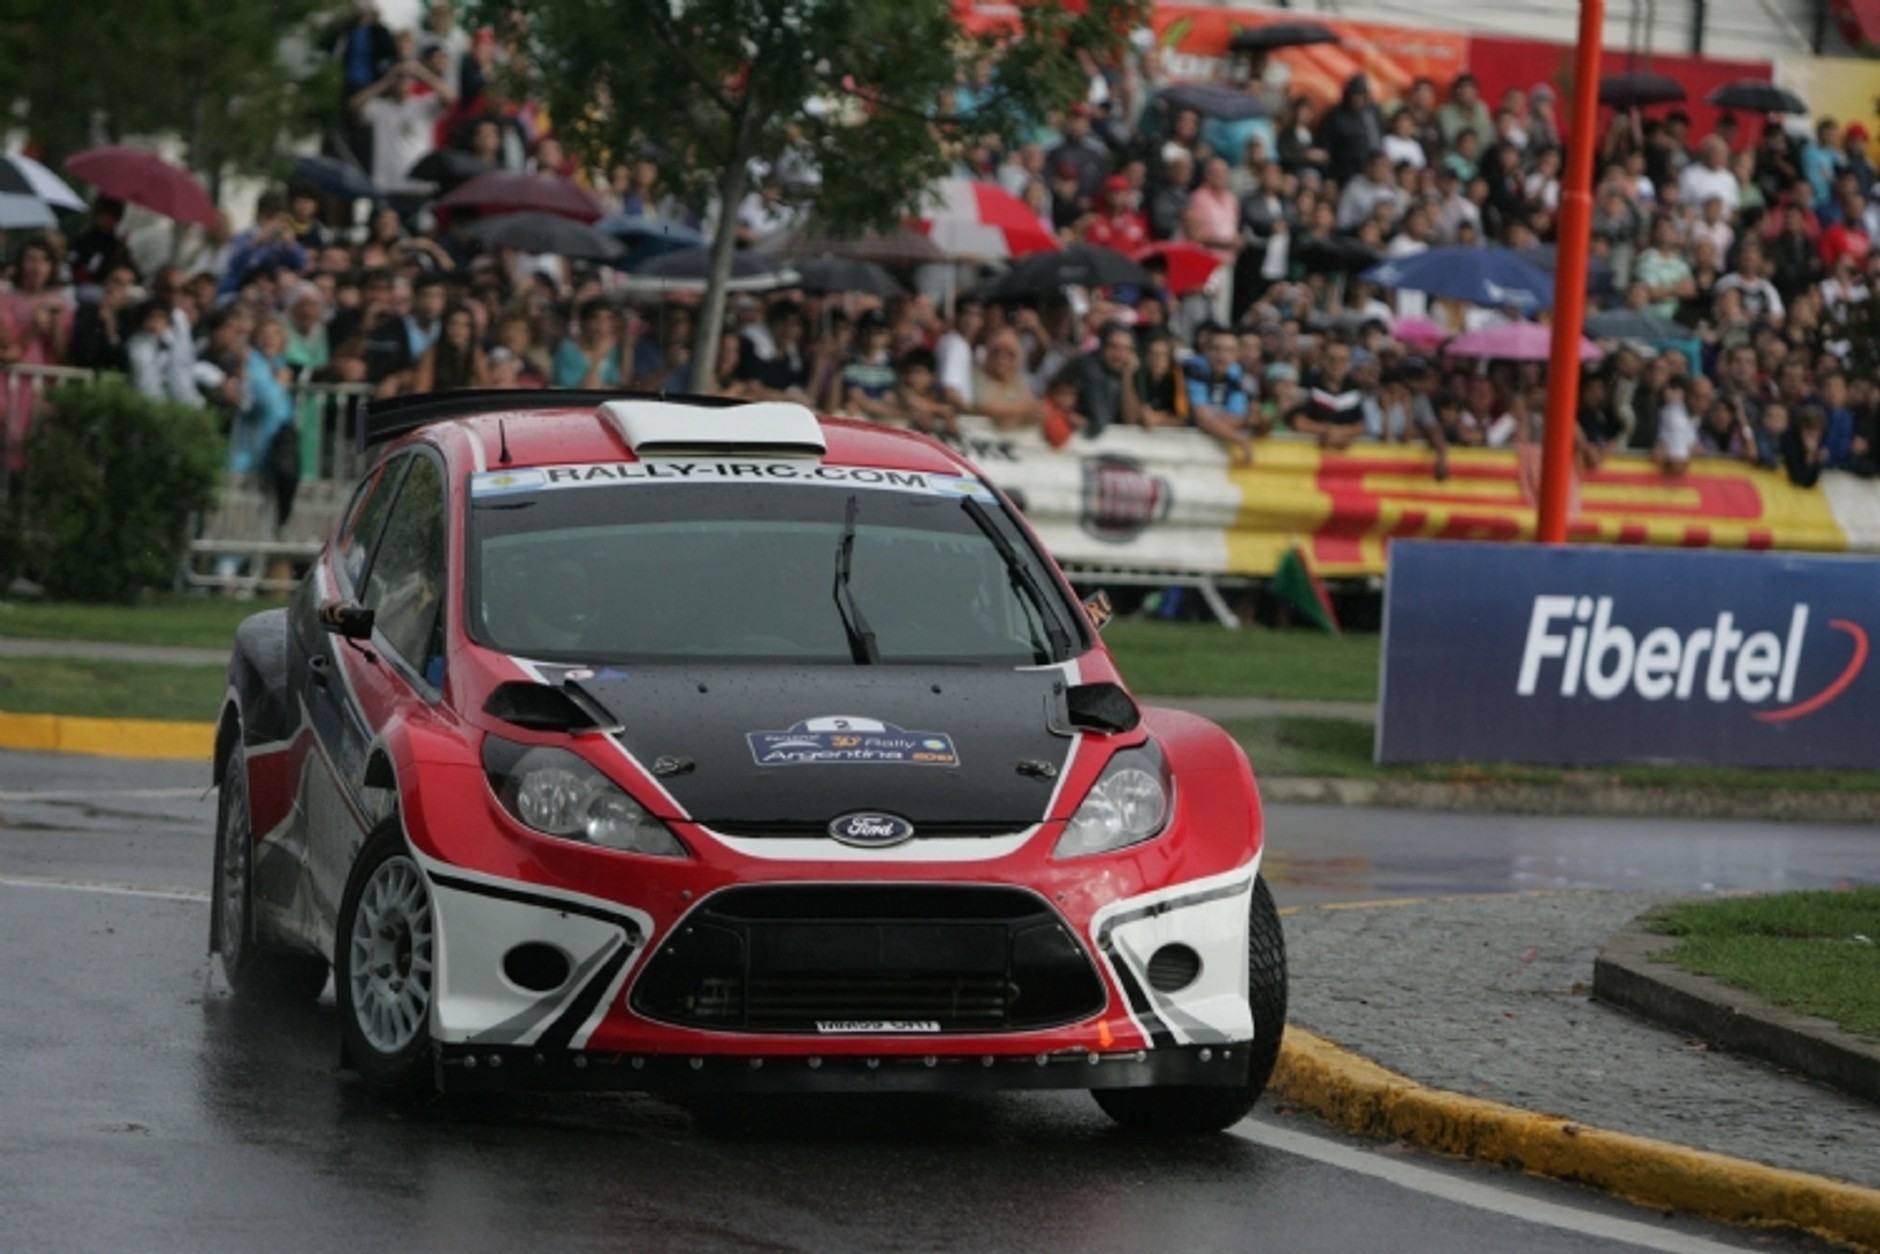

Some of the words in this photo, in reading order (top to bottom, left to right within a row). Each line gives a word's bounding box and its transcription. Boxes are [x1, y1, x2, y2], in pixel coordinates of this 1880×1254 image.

[547, 463, 927, 489] RALLY-IRC.COM
[1516, 595, 1809, 703] Fibertel
[864, 737, 916, 750] Rally
[762, 748, 903, 763] Argentina
[846, 816, 894, 837] Ford
